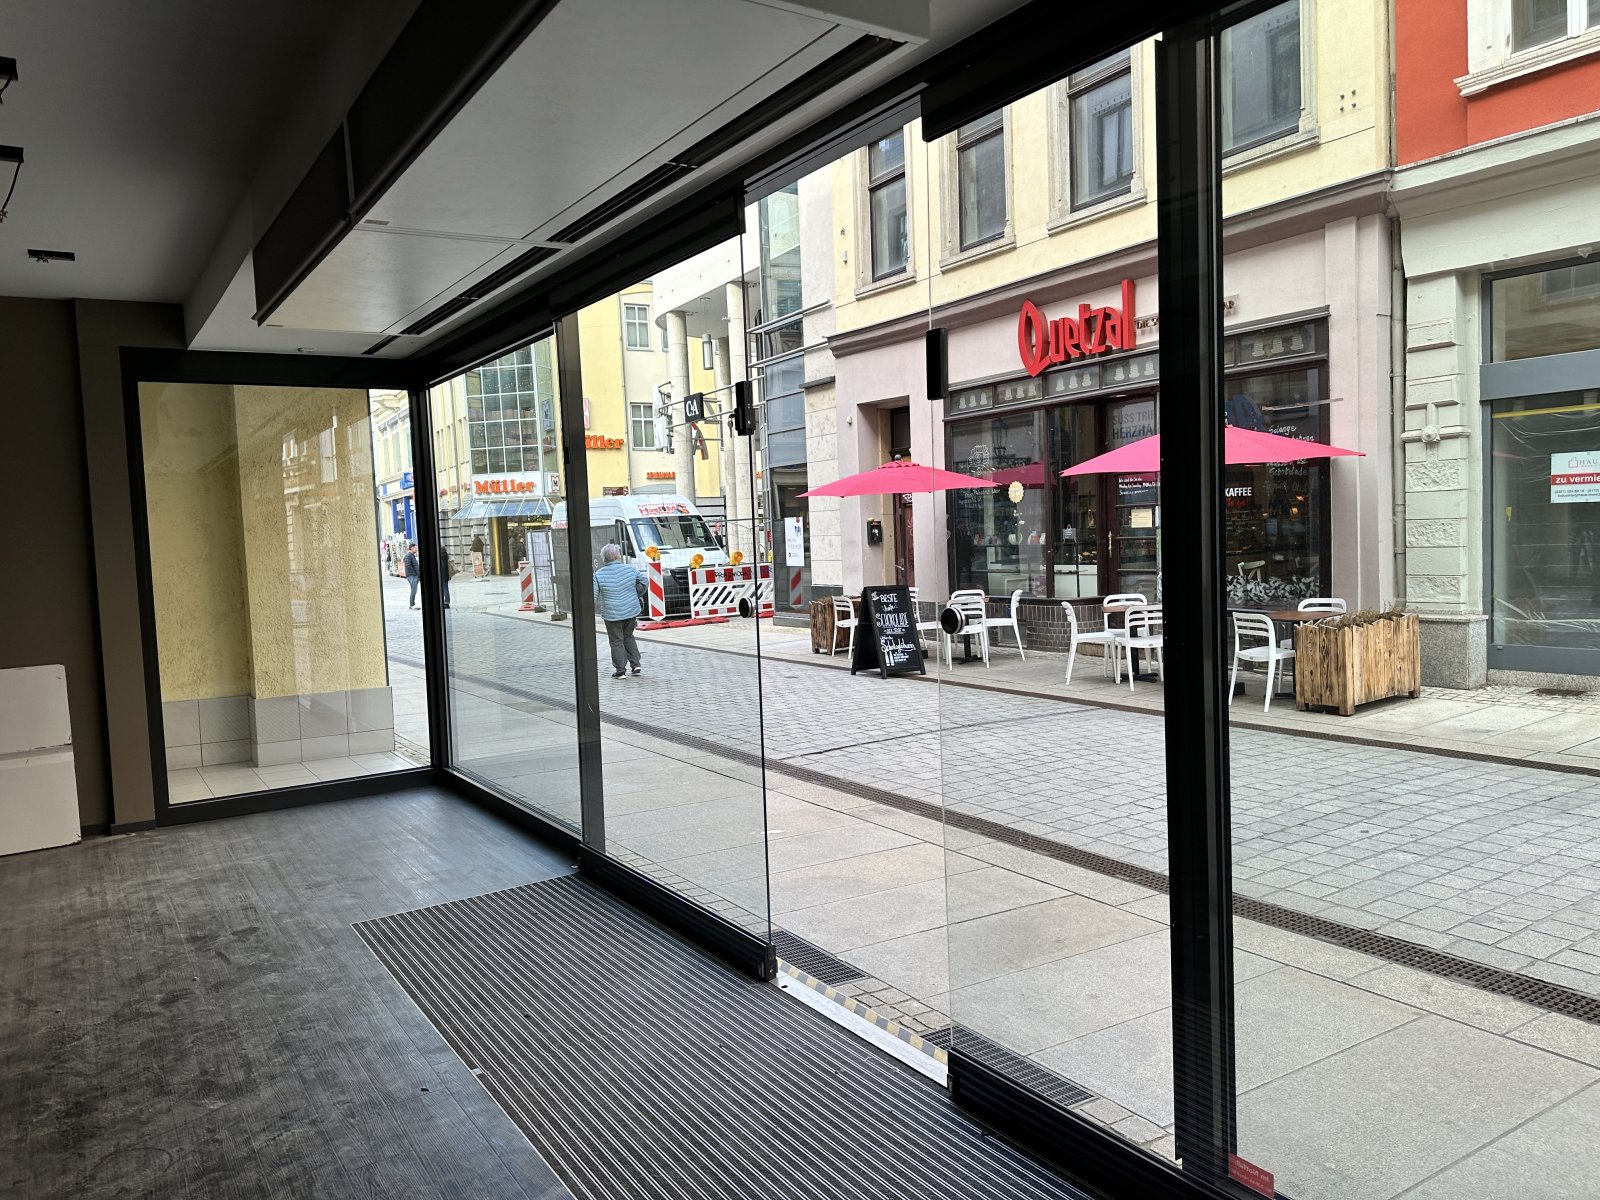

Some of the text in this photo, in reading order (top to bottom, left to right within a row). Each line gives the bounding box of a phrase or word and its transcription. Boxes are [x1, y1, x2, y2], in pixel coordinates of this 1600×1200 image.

[1018, 279, 1136, 377] Quetzal
[474, 479, 535, 495] Müller
[880, 593, 898, 603] BESTE
